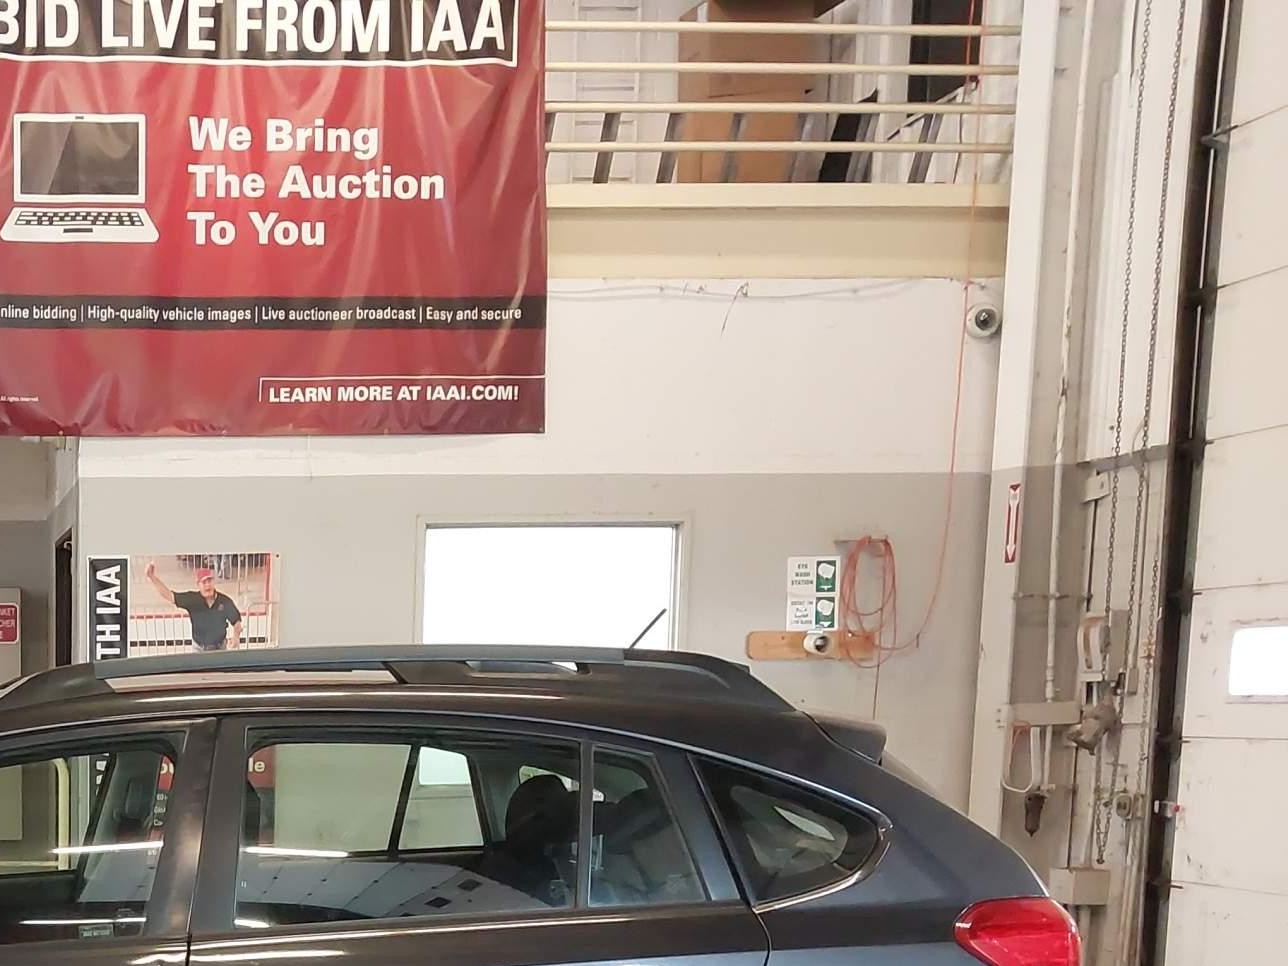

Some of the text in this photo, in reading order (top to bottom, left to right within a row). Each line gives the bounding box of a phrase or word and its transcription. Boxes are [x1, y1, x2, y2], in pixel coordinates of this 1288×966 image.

[101, 0, 223, 50] LIVE
[235, 0, 391, 53] FROM
[410, 0, 505, 52] IAA
[188, 116, 379, 160] We Bring
[187, 164, 444, 200] The Auction
[186, 211, 325, 246] To You
[33, 304, 77, 322] bidding
[87, 305, 160, 323] High-quality
[162, 306, 205, 321] vehicle
[207, 306, 252, 323] images
[261, 306, 286, 320] Live
[289, 307, 353, 321] auctioneer
[355, 306, 417, 320] broadcast
[426, 306, 454, 323] Easy
[456, 306, 478, 320] and
[481, 307, 522, 320] secure
[269, 385, 519, 403] LEARN MORE AT IAAI.COM!
[95, 564, 121, 614] IAA
